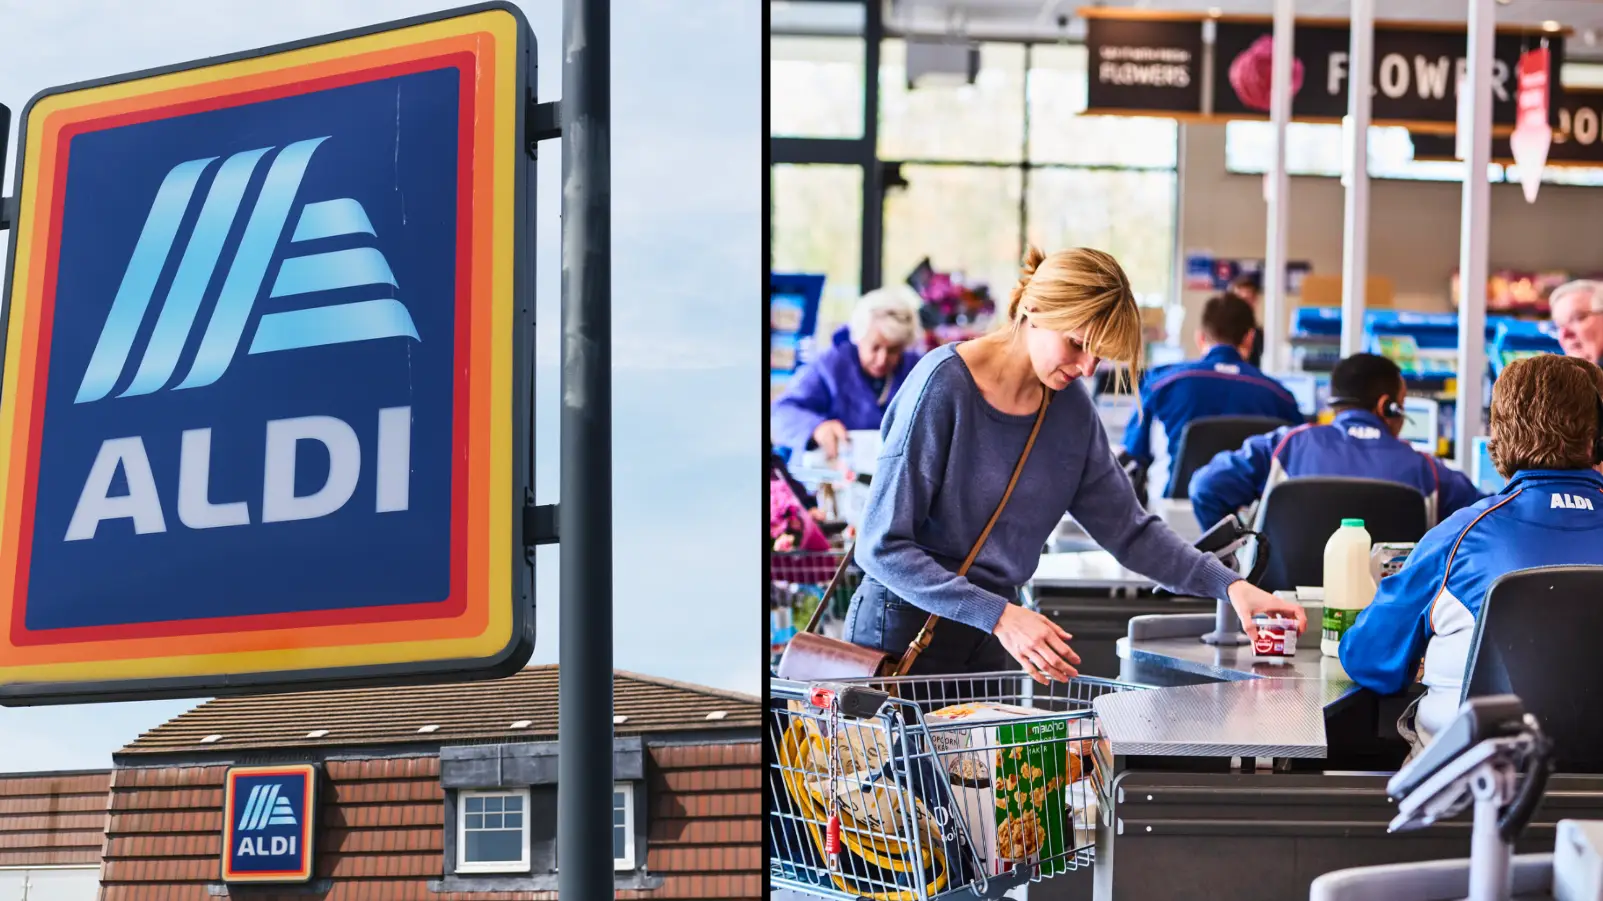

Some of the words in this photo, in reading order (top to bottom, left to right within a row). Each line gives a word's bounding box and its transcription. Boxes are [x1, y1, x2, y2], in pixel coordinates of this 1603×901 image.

[1099, 61, 1191, 88] FLOWERS
[1347, 425, 1382, 440] ALDI
[64, 405, 411, 542] ALDI
[1550, 492, 1594, 511] ALDI
[236, 835, 297, 857] ALDI
